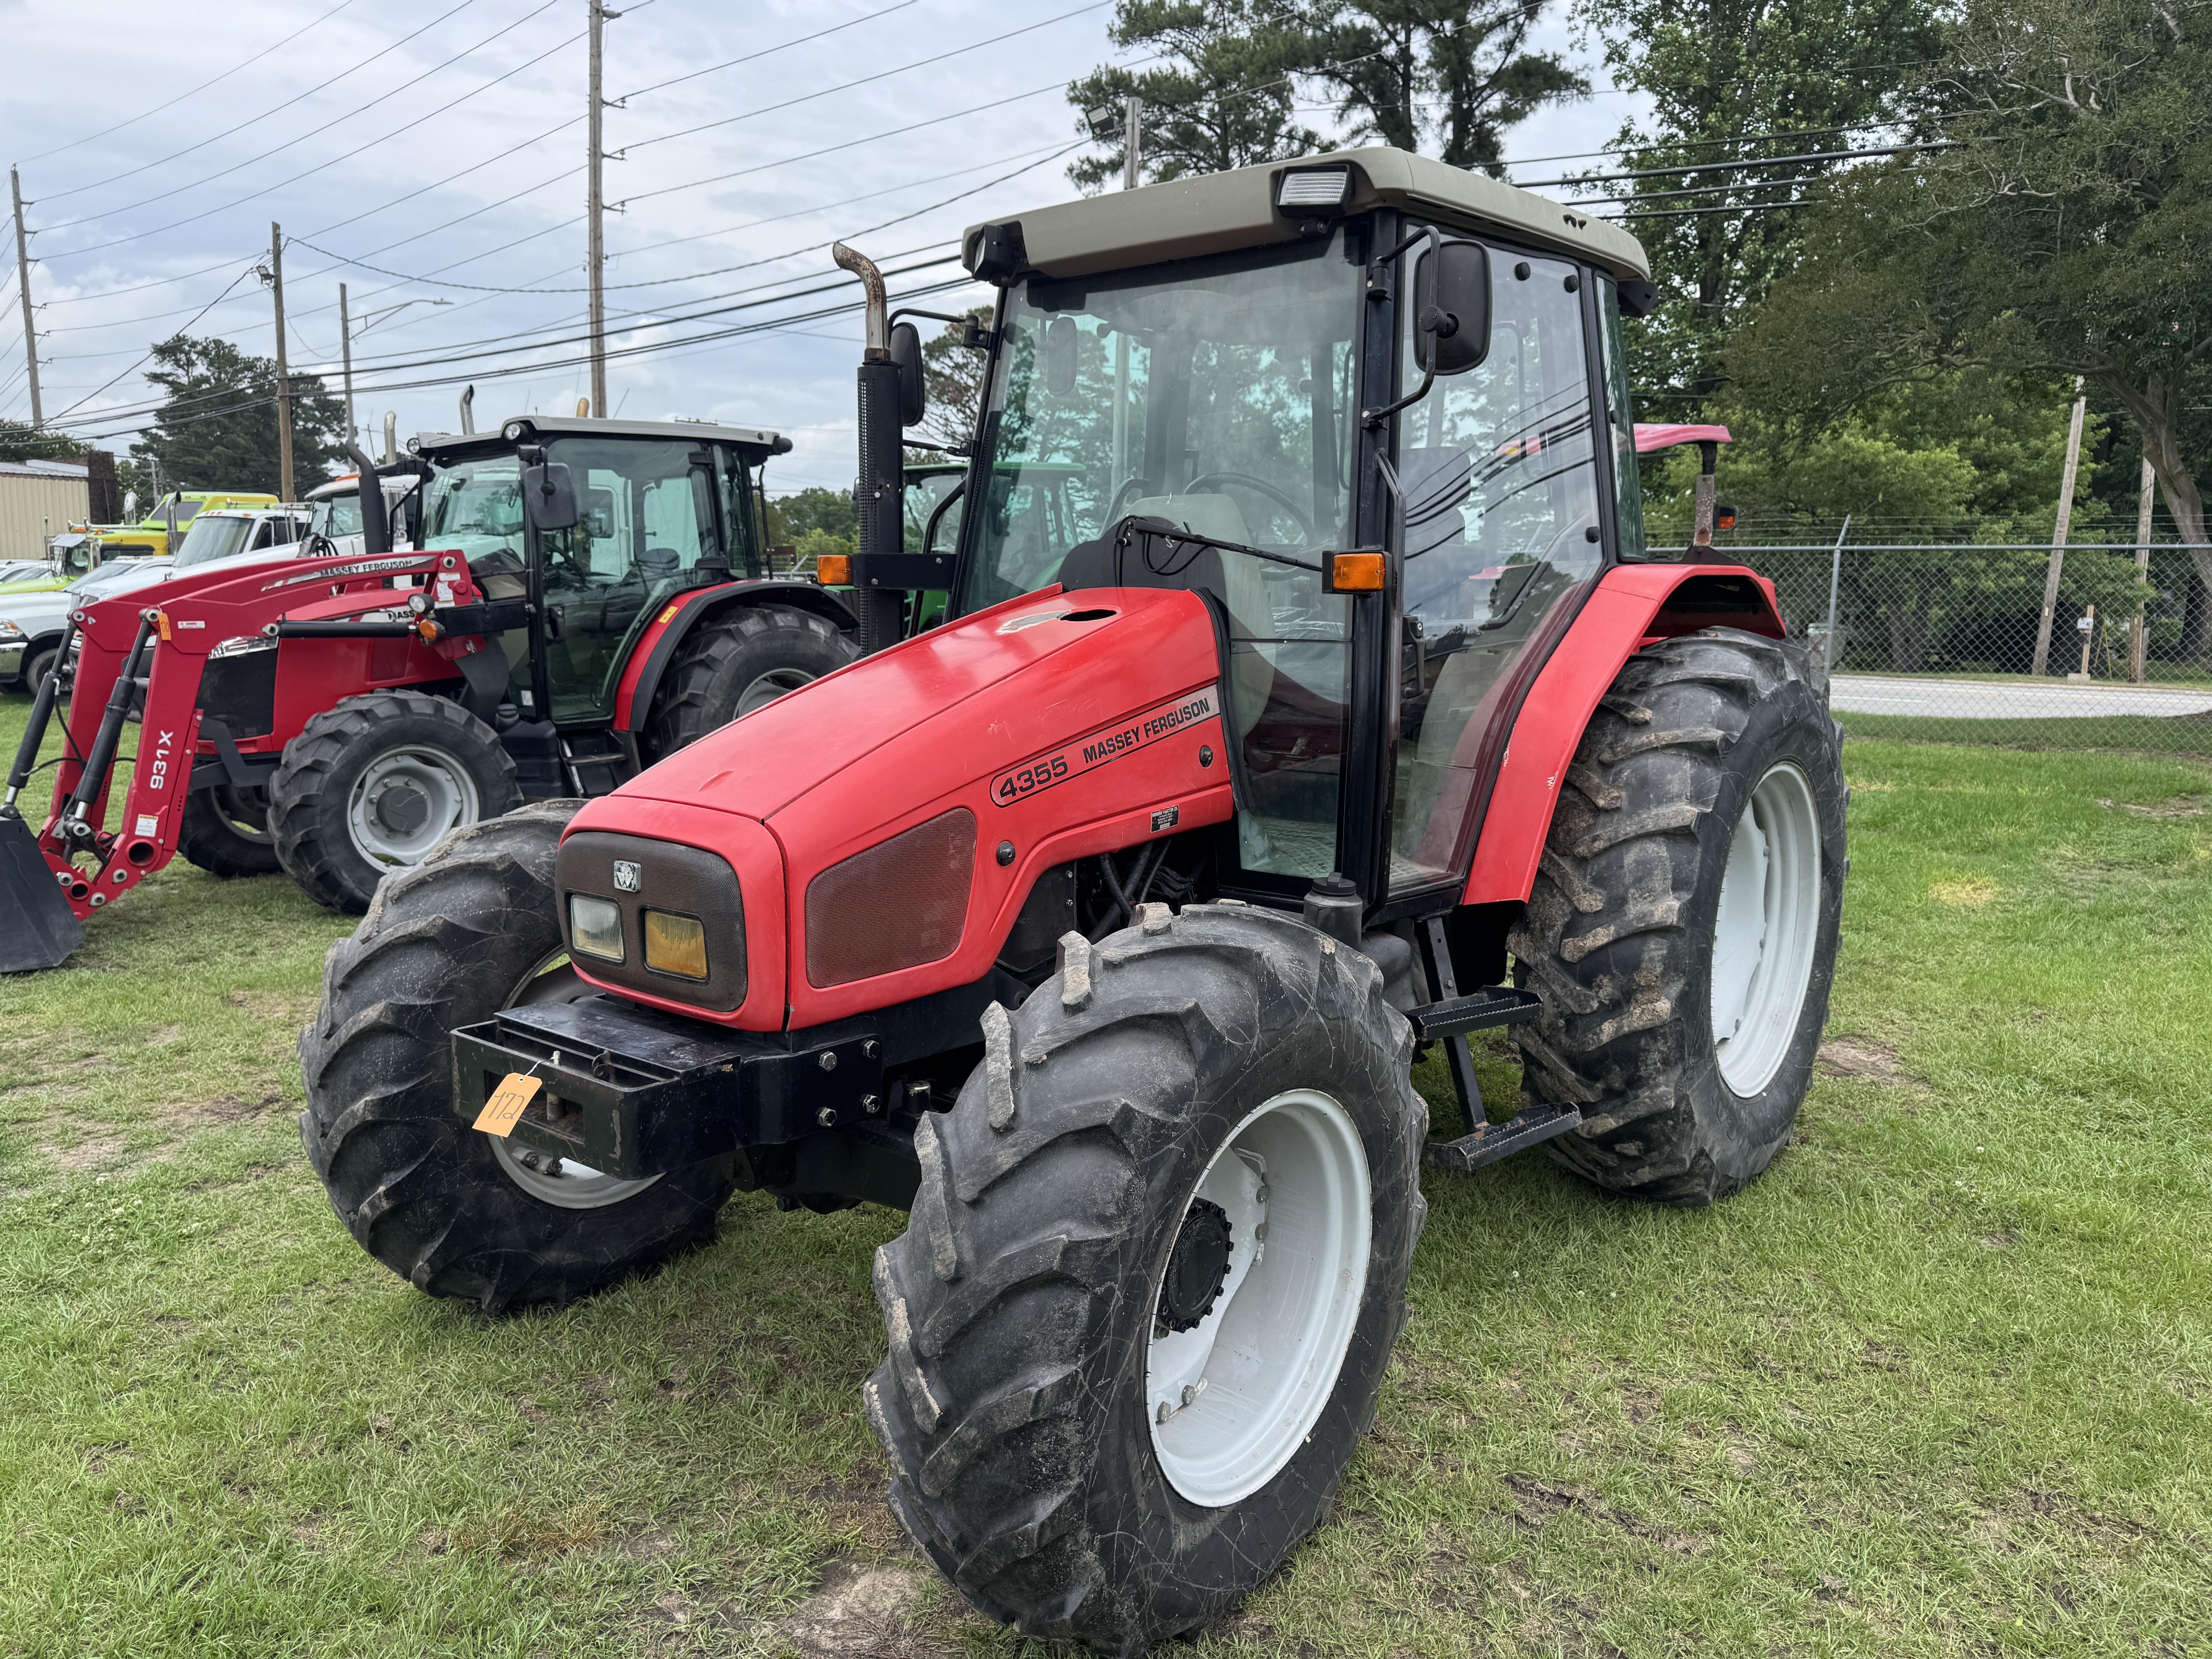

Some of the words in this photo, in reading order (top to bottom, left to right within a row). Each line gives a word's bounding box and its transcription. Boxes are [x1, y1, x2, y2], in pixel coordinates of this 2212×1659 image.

[320, 565, 359, 577] MASSEY
[363, 560, 412, 572] FERGUSON
[388, 610, 415, 620] MASS
[150, 730, 173, 790] 931X
[999, 755, 1068, 798] 4355
[1083, 726, 1140, 764] MASSEY
[1143, 698, 1210, 738] FERGUSON
[488, 1091, 525, 1120] 172
